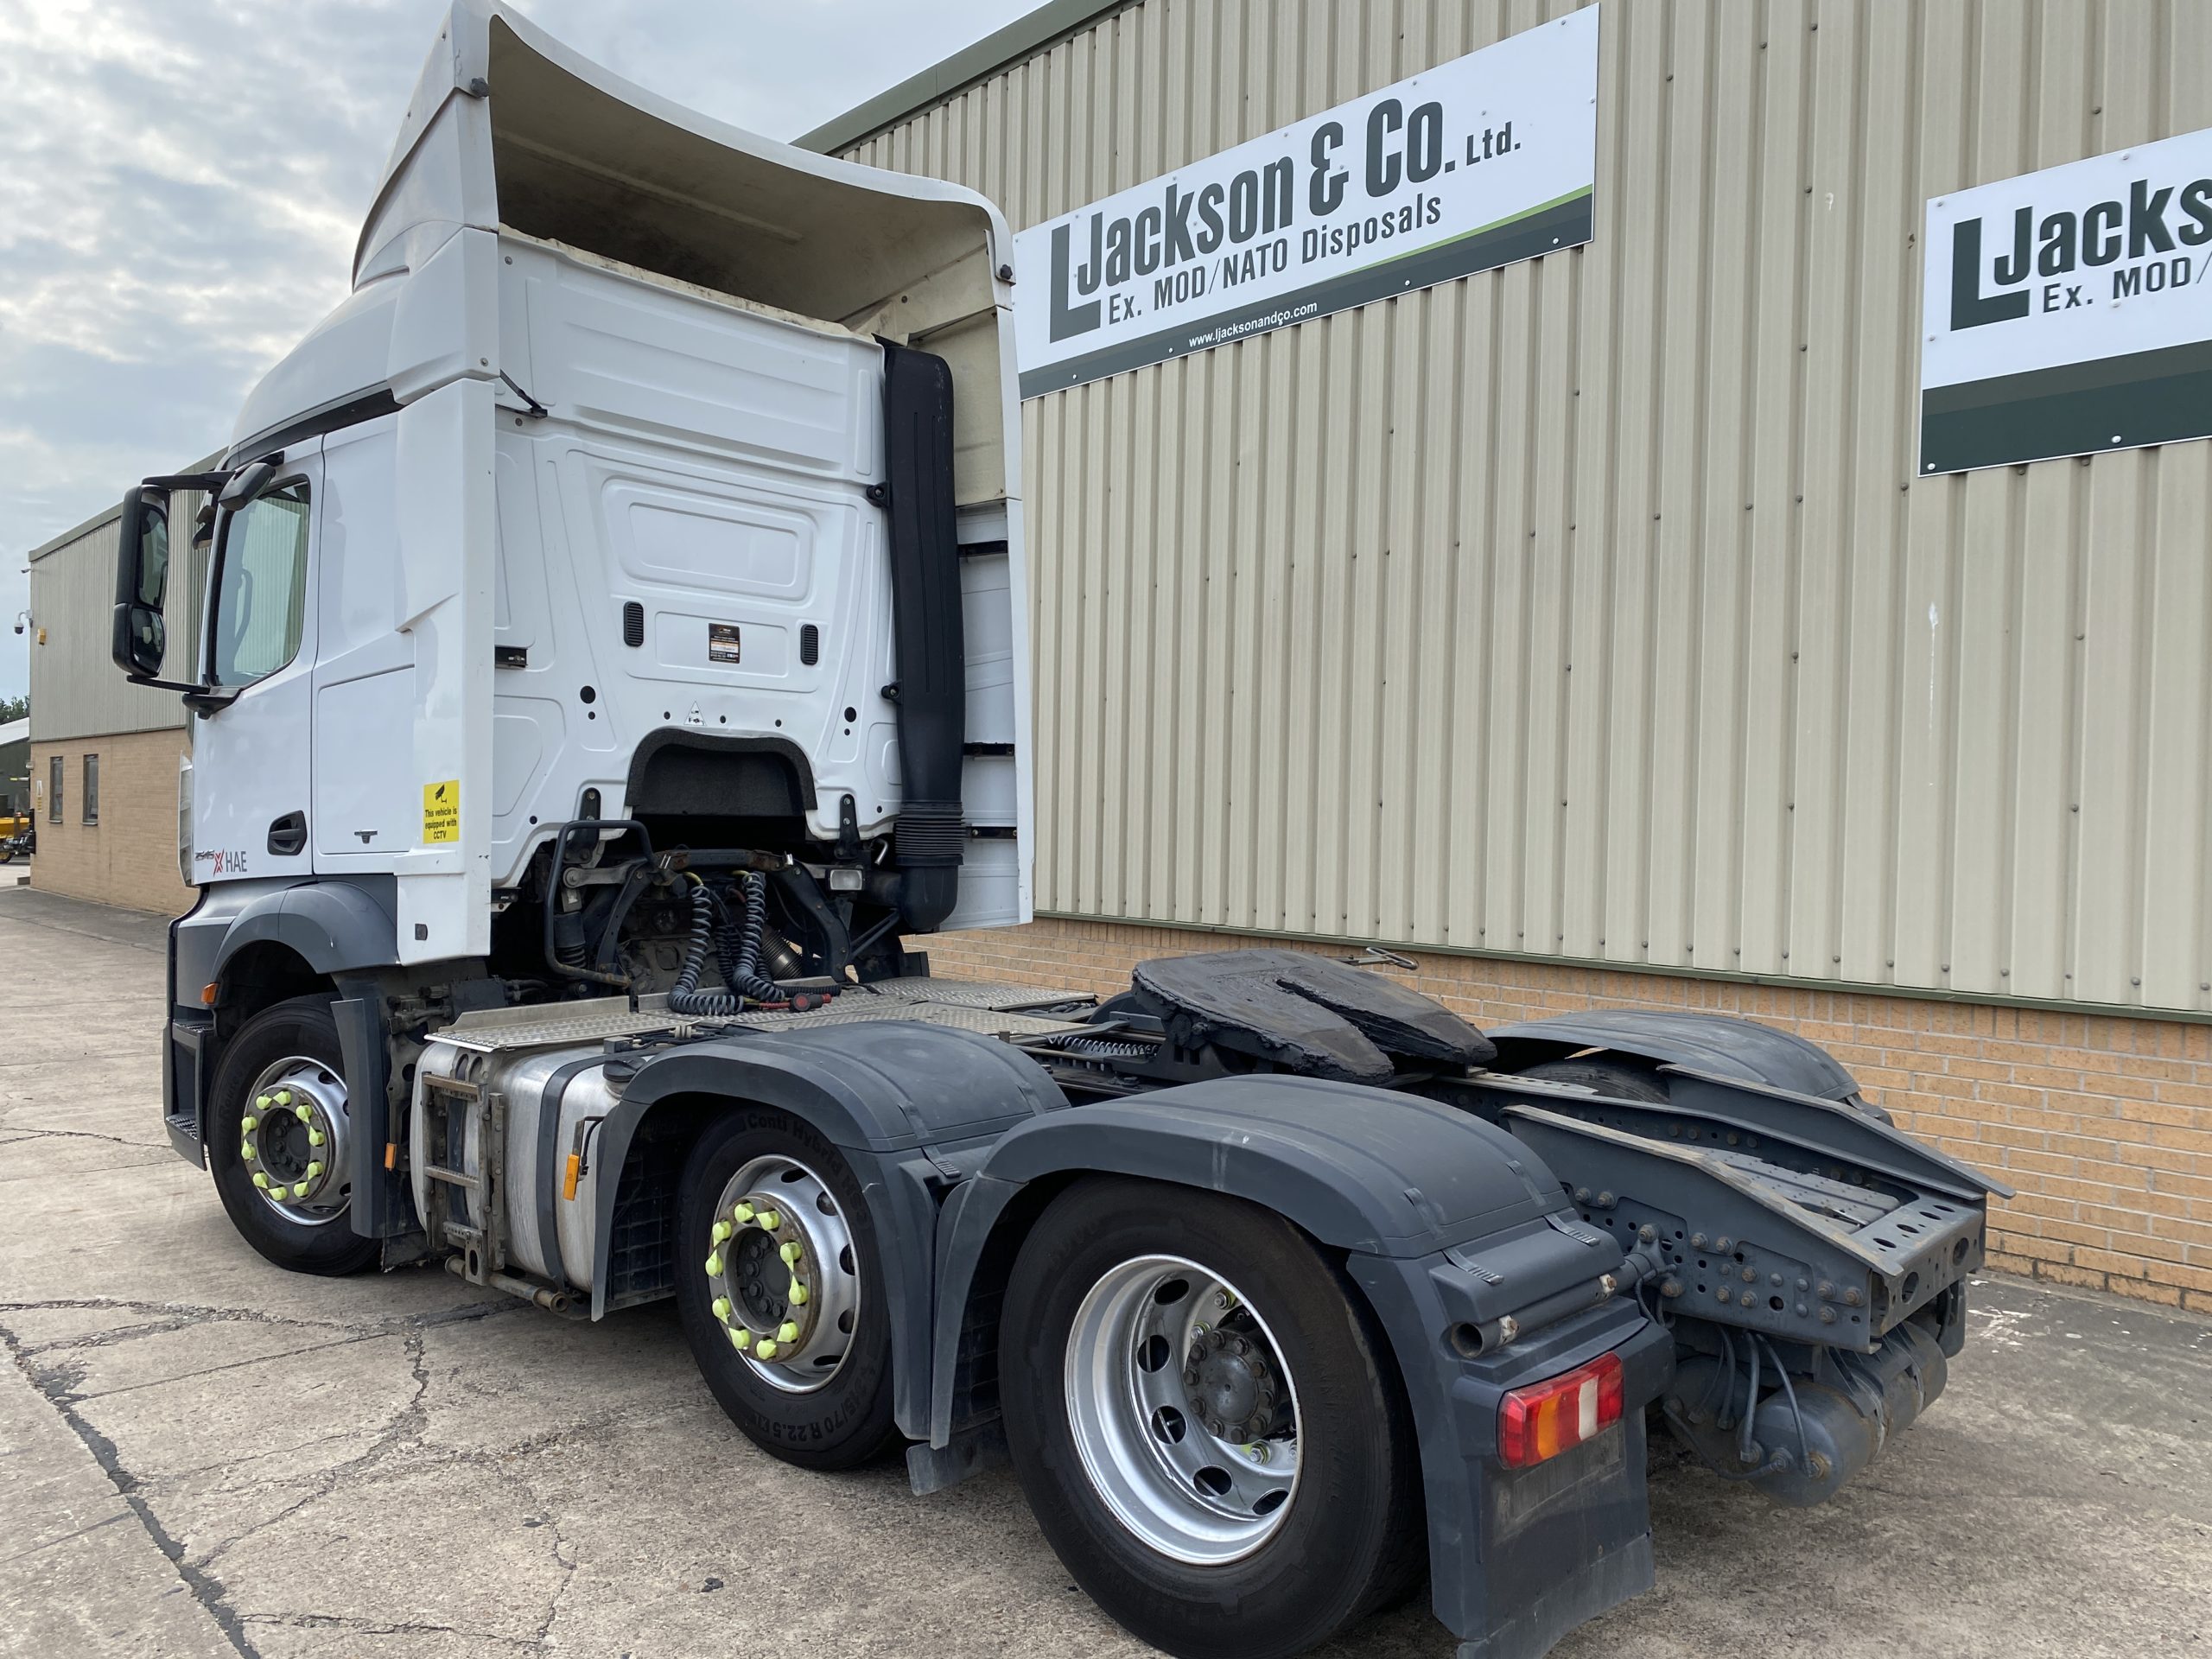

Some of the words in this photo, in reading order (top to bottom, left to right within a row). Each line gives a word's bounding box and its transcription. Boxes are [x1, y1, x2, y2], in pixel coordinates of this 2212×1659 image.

[1308, 121, 1350, 217] &
[1366, 98, 1456, 198] Co.
[1466, 121, 1522, 166] Ltd.
[1109, 294, 1141, 325] Ex.
[1154, 238, 1288, 309] MOD/NATO
[1302, 193, 1442, 264] Disposals
[2044, 283, 2094, 313] Ex.
[1188, 302, 1318, 347] www.ljacksonandco.com
[425, 809, 434, 817] This
[435, 807, 452, 817] vehicle
[453, 805, 457, 814] is
[425, 818, 445, 830] equipped
[446, 817, 457, 827] with
[433, 830, 447, 840] CCTV
[747, 1112, 788, 1133] Conti
[793, 1121, 843, 1176] Hybrid
